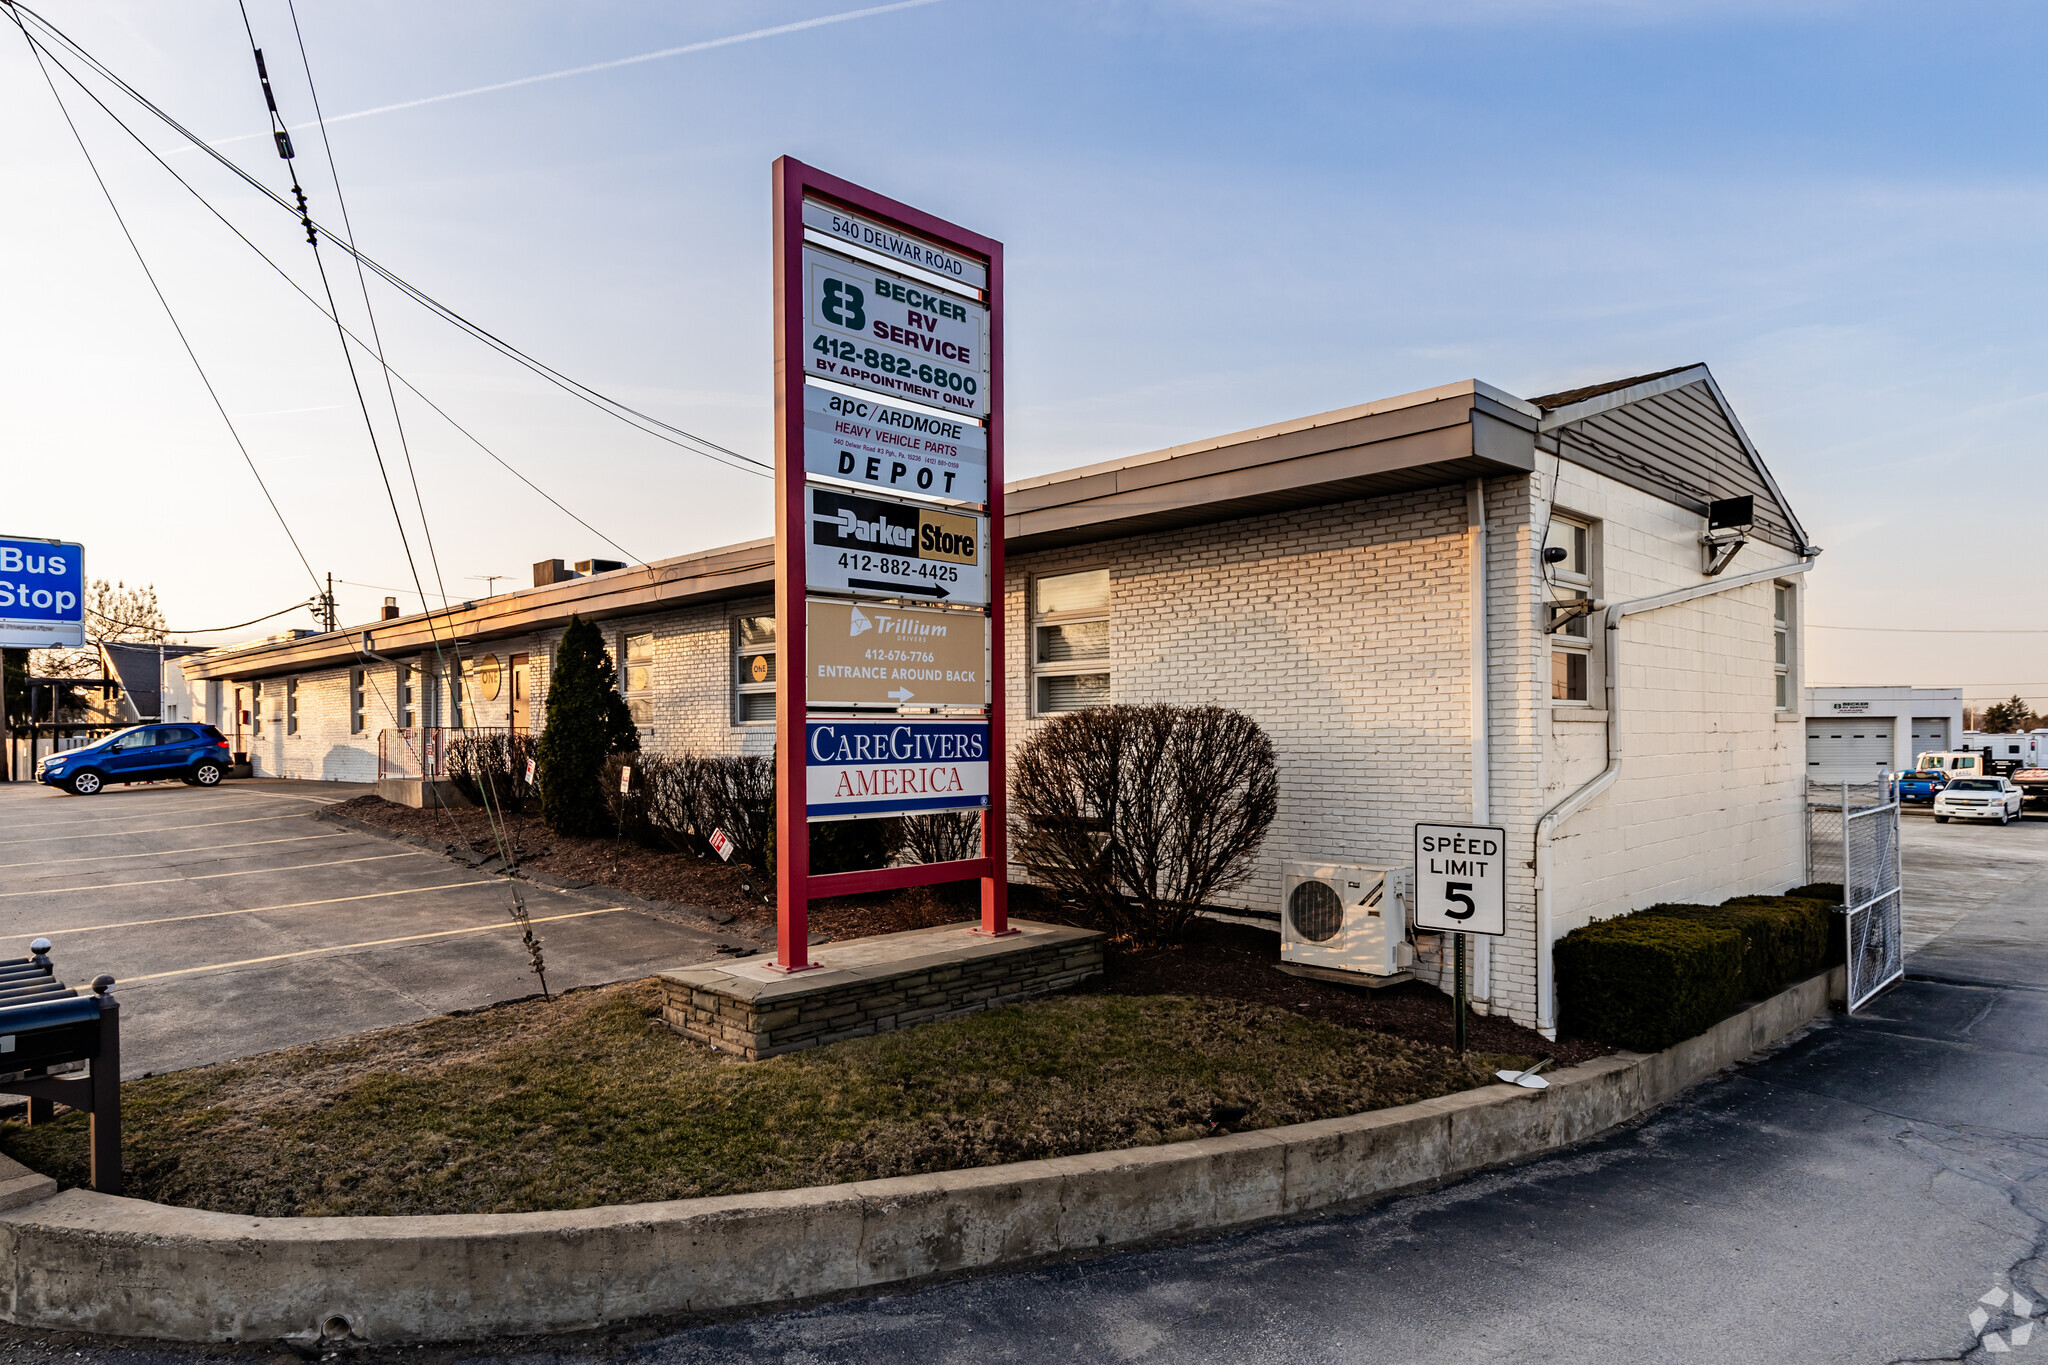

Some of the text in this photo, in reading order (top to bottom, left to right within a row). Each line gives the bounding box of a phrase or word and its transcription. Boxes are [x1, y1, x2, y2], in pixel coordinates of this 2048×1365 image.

[832, 216, 963, 275] 540 DELWAR ROAD
[875, 277, 967, 323] BECKER
[907, 309, 938, 333] RV
[872, 320, 970, 364] SERVICE
[812, 334, 977, 396] 412-882-6800
[816, 357, 975, 409] BY APPOINTMENT ONLY
[833, 437, 844, 446] 540
[845, 440, 862, 450] Delwar
[863, 444, 876, 453] Road
[877, 447, 885, 455] #3
[907, 453, 922, 462] 15236
[924, 456, 937, 465] (412)
[834, 420, 958, 457] HEAVY VEHICLE PARTS
[838, 450, 956, 494] DEPOT
[837, 508, 975, 557] Parker Store
[0, 546, 67, 576] Bus
[838, 552, 958, 582] 412-882-4425
[0, 580, 76, 614] Stop
[874, 615, 947, 637] Trillium
[897, 634, 927, 643] DRIVERS
[753, 664, 766, 673] ONE
[864, 648, 934, 663] 412-676-7766
[482, 671, 498, 684] ONE
[817, 664, 976, 683] ENTRANCE AROUND BACK
[834, 766, 964, 798] AMERICA
[1422, 836, 1498, 856] SPEED
[1430, 858, 1489, 878] LIMIT
[1444, 881, 1476, 920] 5
